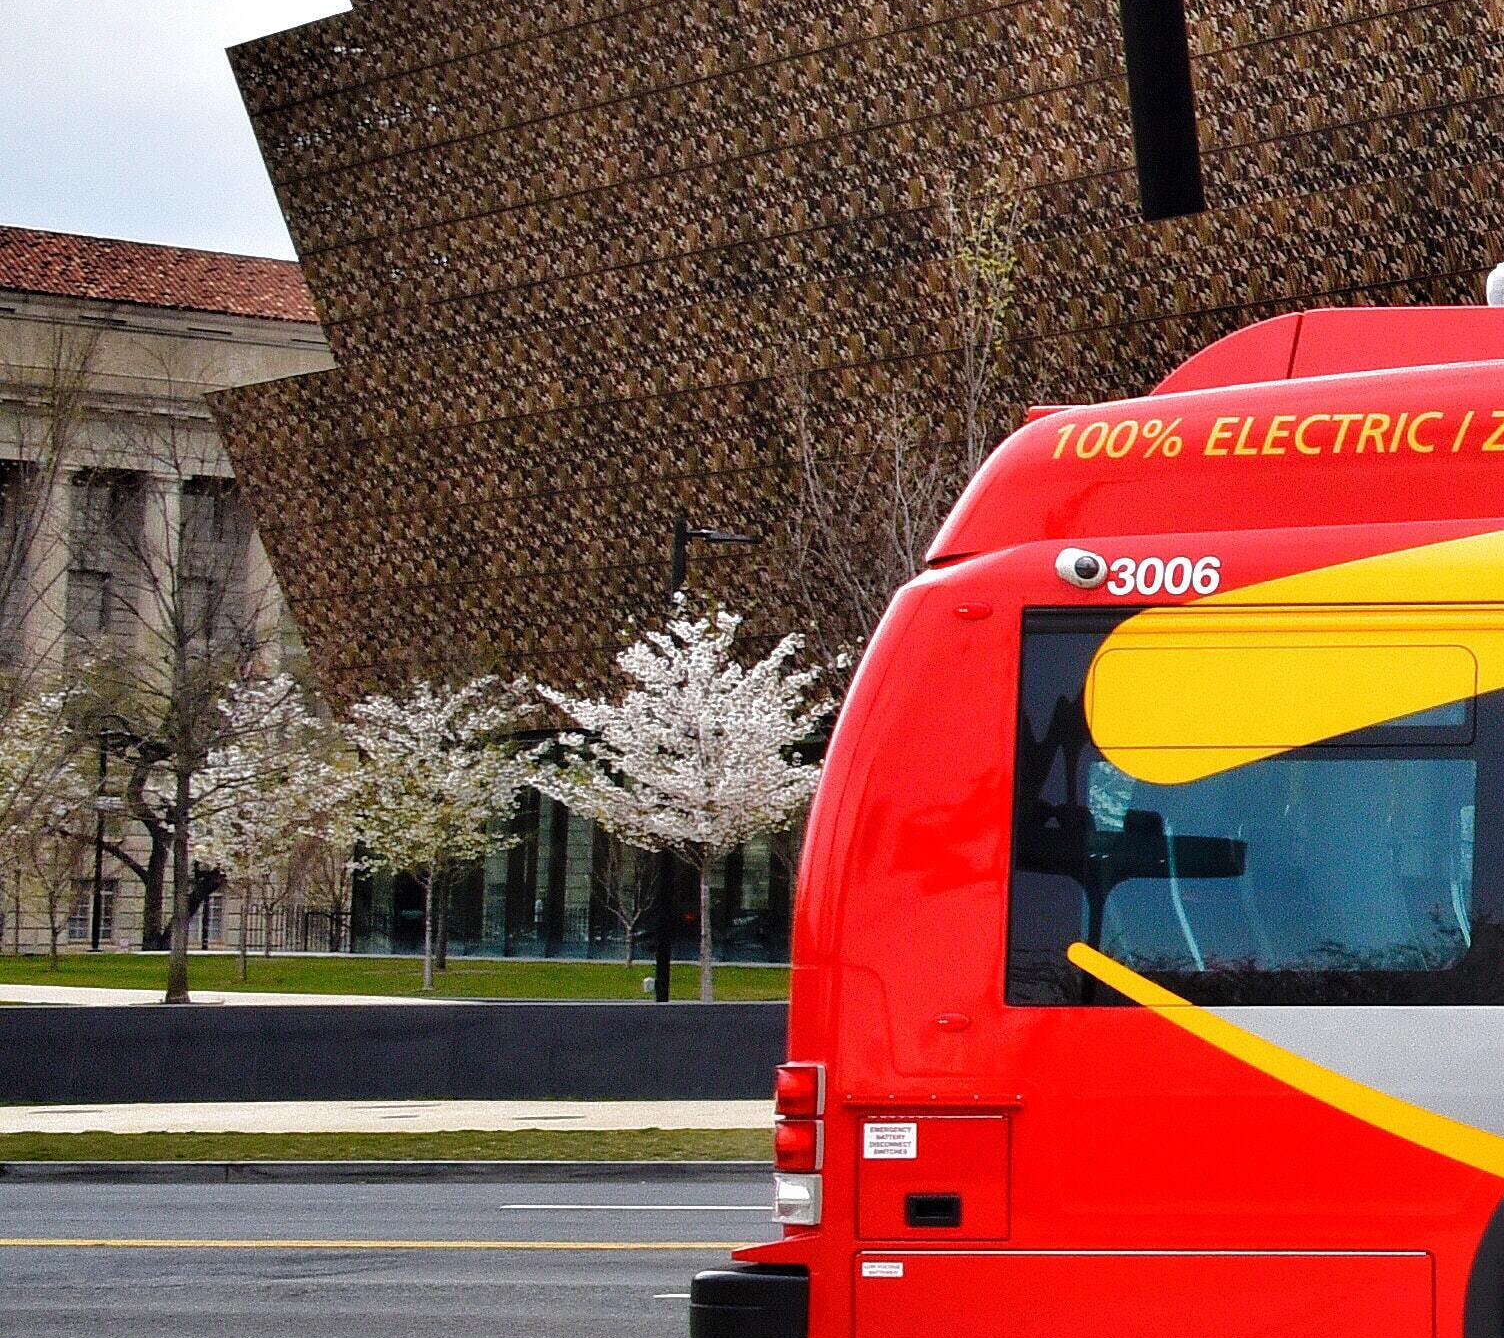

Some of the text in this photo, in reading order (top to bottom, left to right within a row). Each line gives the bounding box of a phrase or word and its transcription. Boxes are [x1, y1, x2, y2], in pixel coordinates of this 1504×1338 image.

[1052, 417, 1183, 460] 100%
[1203, 411, 1445, 457] ELECTRIC
[1451, 410, 1476, 453] /
[1106, 555, 1221, 597] 3006
